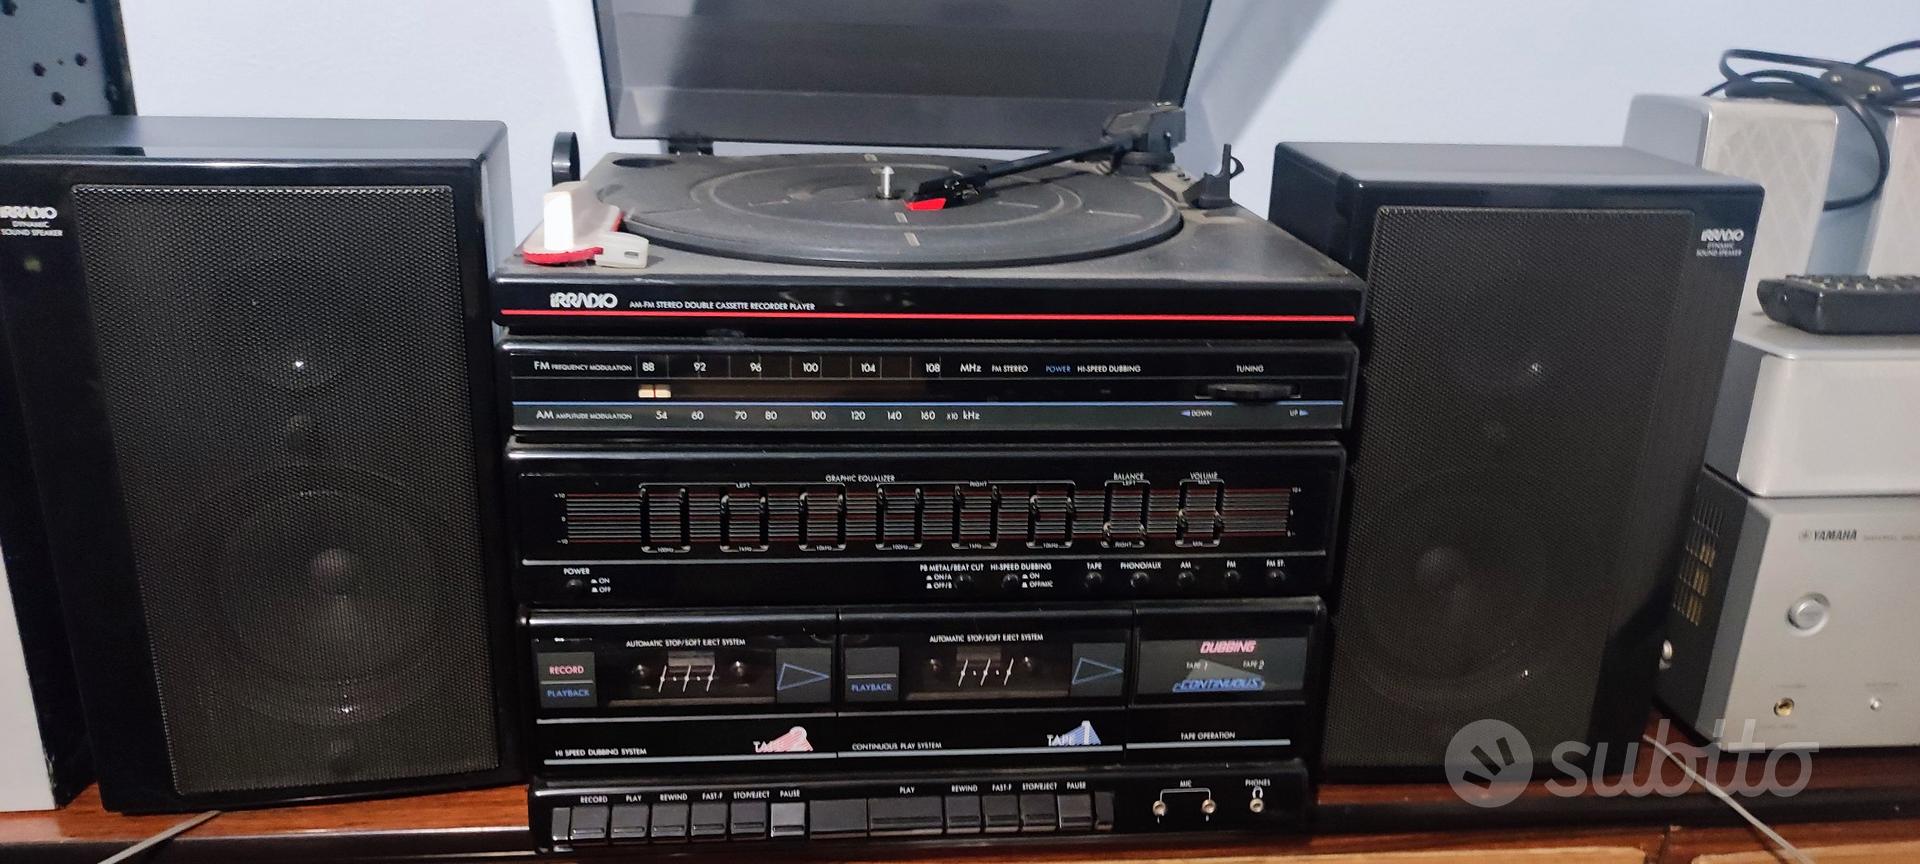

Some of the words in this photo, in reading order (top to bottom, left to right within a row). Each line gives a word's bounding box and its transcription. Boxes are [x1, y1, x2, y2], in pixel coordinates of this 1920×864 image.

[550, 292, 618, 308] IRRADIO
[656, 301, 683, 309] STEREO
[684, 301, 714, 309] DOUBLE
[715, 302, 749, 310] CASSETTE
[534, 361, 550, 370] FM
[642, 362, 655, 371] 88
[693, 362, 706, 372] 92
[750, 362, 762, 372] 96
[803, 363, 819, 372] 100
[861, 363, 876, 373] 104
[925, 363, 940, 373] 108
[960, 364, 981, 373] MHz
[1003, 365, 1029, 373] STEREO
[1236, 365, 1264, 373] TUNING
[536, 410, 554, 419] AM
[655, 410, 668, 420] 54
[691, 411, 704, 420] 60
[735, 411, 747, 420] 70
[765, 411, 778, 420] 80
[811, 411, 827, 421] 100
[851, 411, 866, 421] 120
[887, 411, 902, 421] 140
[921, 411, 936, 421] 160
[963, 411, 980, 420] kHz
[825, 474, 856, 482] GRAPHIC
[1113, 472, 1144, 480] BALANCE
[1190, 472, 1218, 480] VOLUME
[1814, 529, 1857, 541] YAMAHA
[920, 564, 928, 572] PB
[929, 564, 969, 572] METAL/BEAT
[990, 563, 1019, 571] HI-SPEED
[1020, 563, 1052, 571] DUBBING
[1087, 562, 1102, 570] TAPE
[1120, 561, 1161, 569] PHONO/AUX
[1180, 561, 1191, 569] AM
[1029, 572, 1040, 580] ON
[626, 639, 664, 647] AUTOMATIC
[665, 639, 701, 647] STOP/SOFT
[702, 638, 720, 646] EJECT
[722, 638, 745, 646] SYSTEM
[929, 635, 965, 643] AUTOMATIC
[967, 634, 1001, 642] STOP/SOFT
[1002, 634, 1019, 642] EJECT
[1021, 633, 1043, 641] SYSTEM
[1200, 639, 1256, 653] DUBBING
[1243, 660, 1257, 668] TAPE
[549, 666, 585, 675] RECORD
[851, 683, 892, 691] PLAYBACK
[1180, 678, 1259, 690] CONTINUOUS
[547, 689, 590, 697] PLAYBACK
[1180, 732, 1196, 740] TAPE
[1197, 731, 1236, 740] OPERATION
[851, 743, 899, 751] CONTINUOUS
[917, 742, 942, 750] SYSTEM
[565, 749, 586, 757] SPEED
[587, 748, 619, 756] DUBBING
[621, 748, 647, 756] SYSTEM
[1066, 781, 1086, 789] PAUSE
[1179, 780, 1192, 788] MIC
[1245, 778, 1271, 787] PHONES
[899, 786, 915, 794] PLAY
[951, 785, 978, 793] REWIND
[992, 784, 1012, 792] FAST-F
[659, 793, 688, 801] REWIND
[780, 789, 801, 797] PAUSE
[580, 795, 608, 804] RECORD
[625, 794, 642, 802] PLAY
